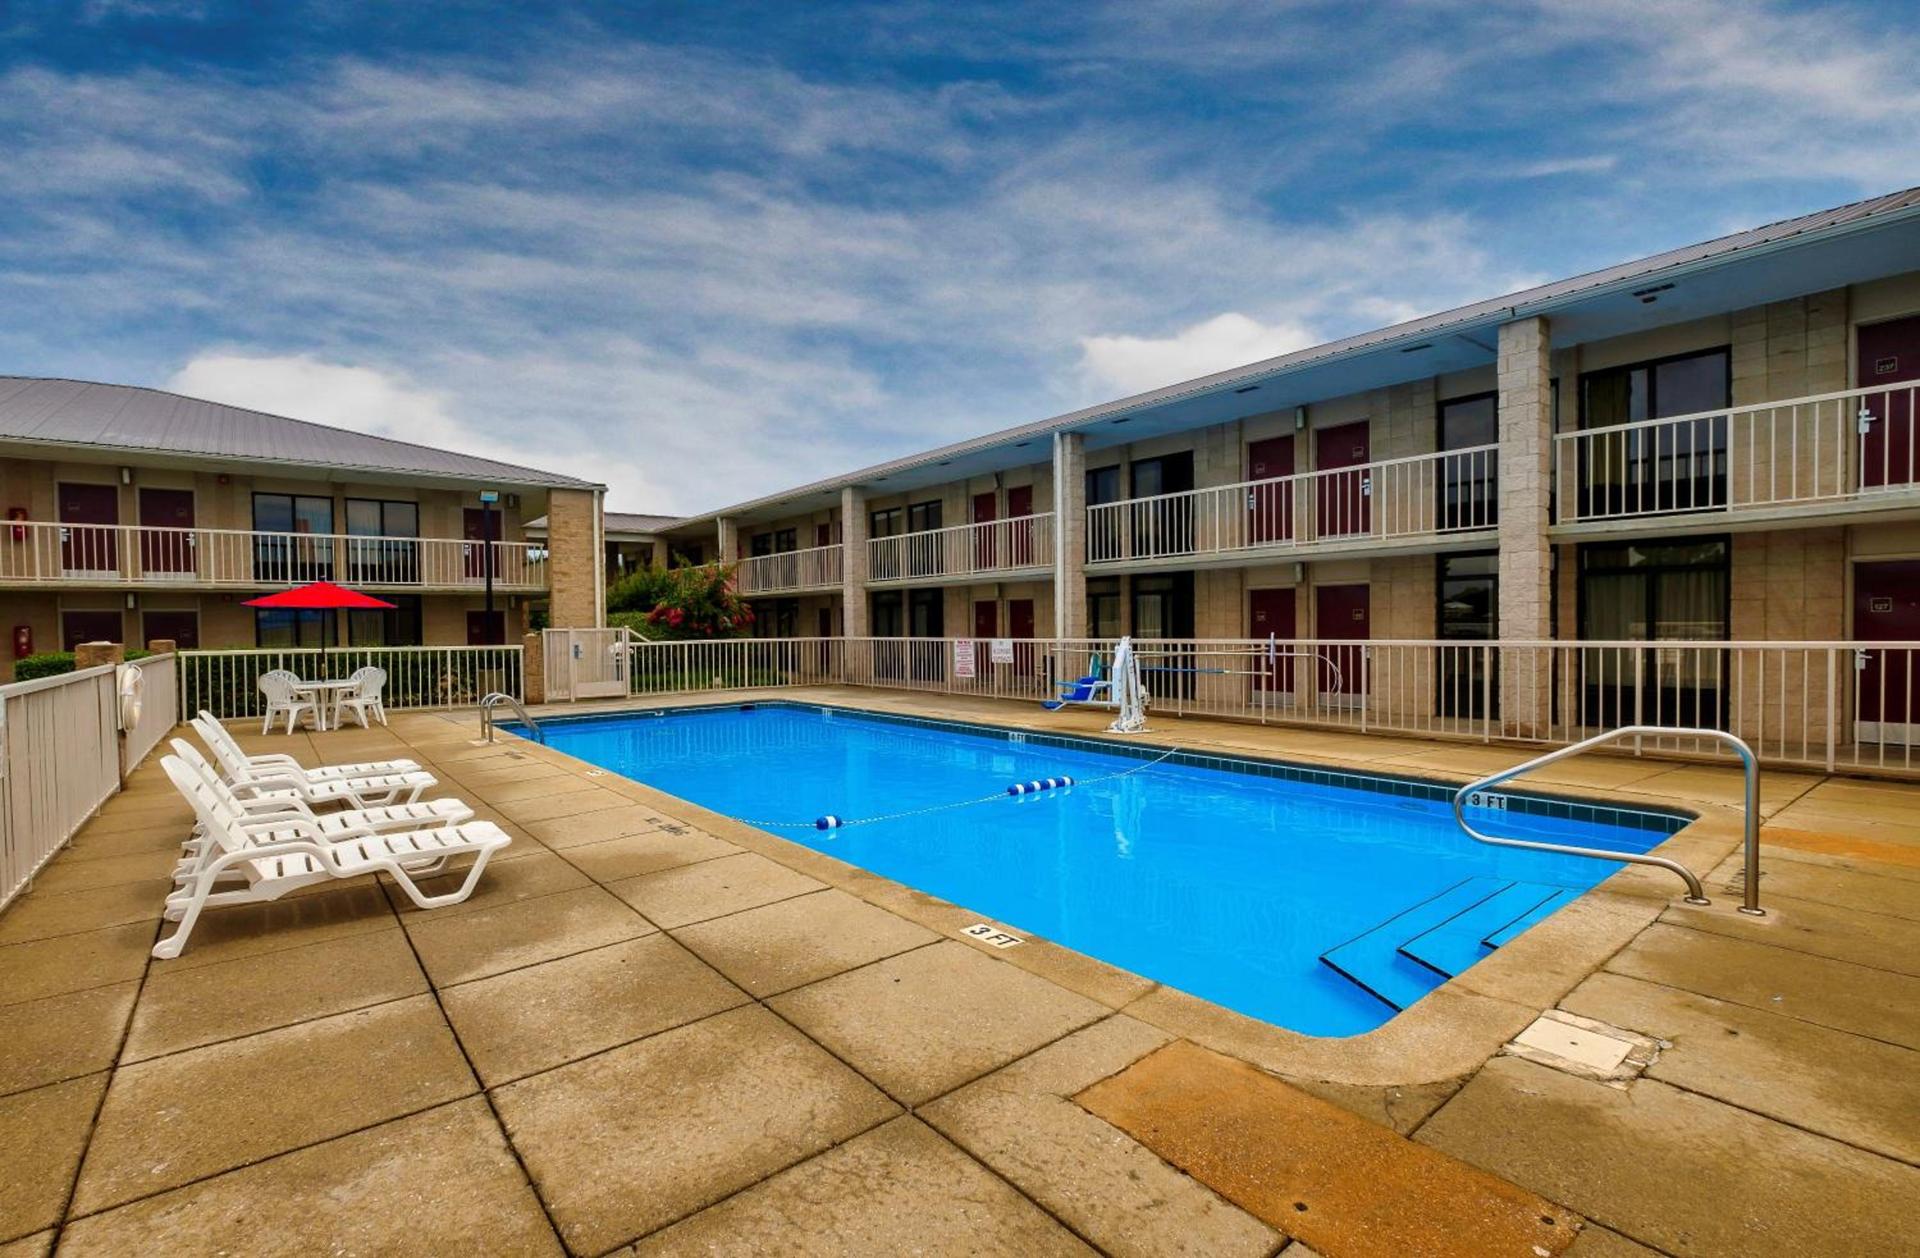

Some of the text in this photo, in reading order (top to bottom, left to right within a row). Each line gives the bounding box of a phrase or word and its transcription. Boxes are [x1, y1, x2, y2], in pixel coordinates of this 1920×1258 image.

[1472, 793, 1505, 809] 3 FT
[969, 927, 1020, 945] 3 FT
